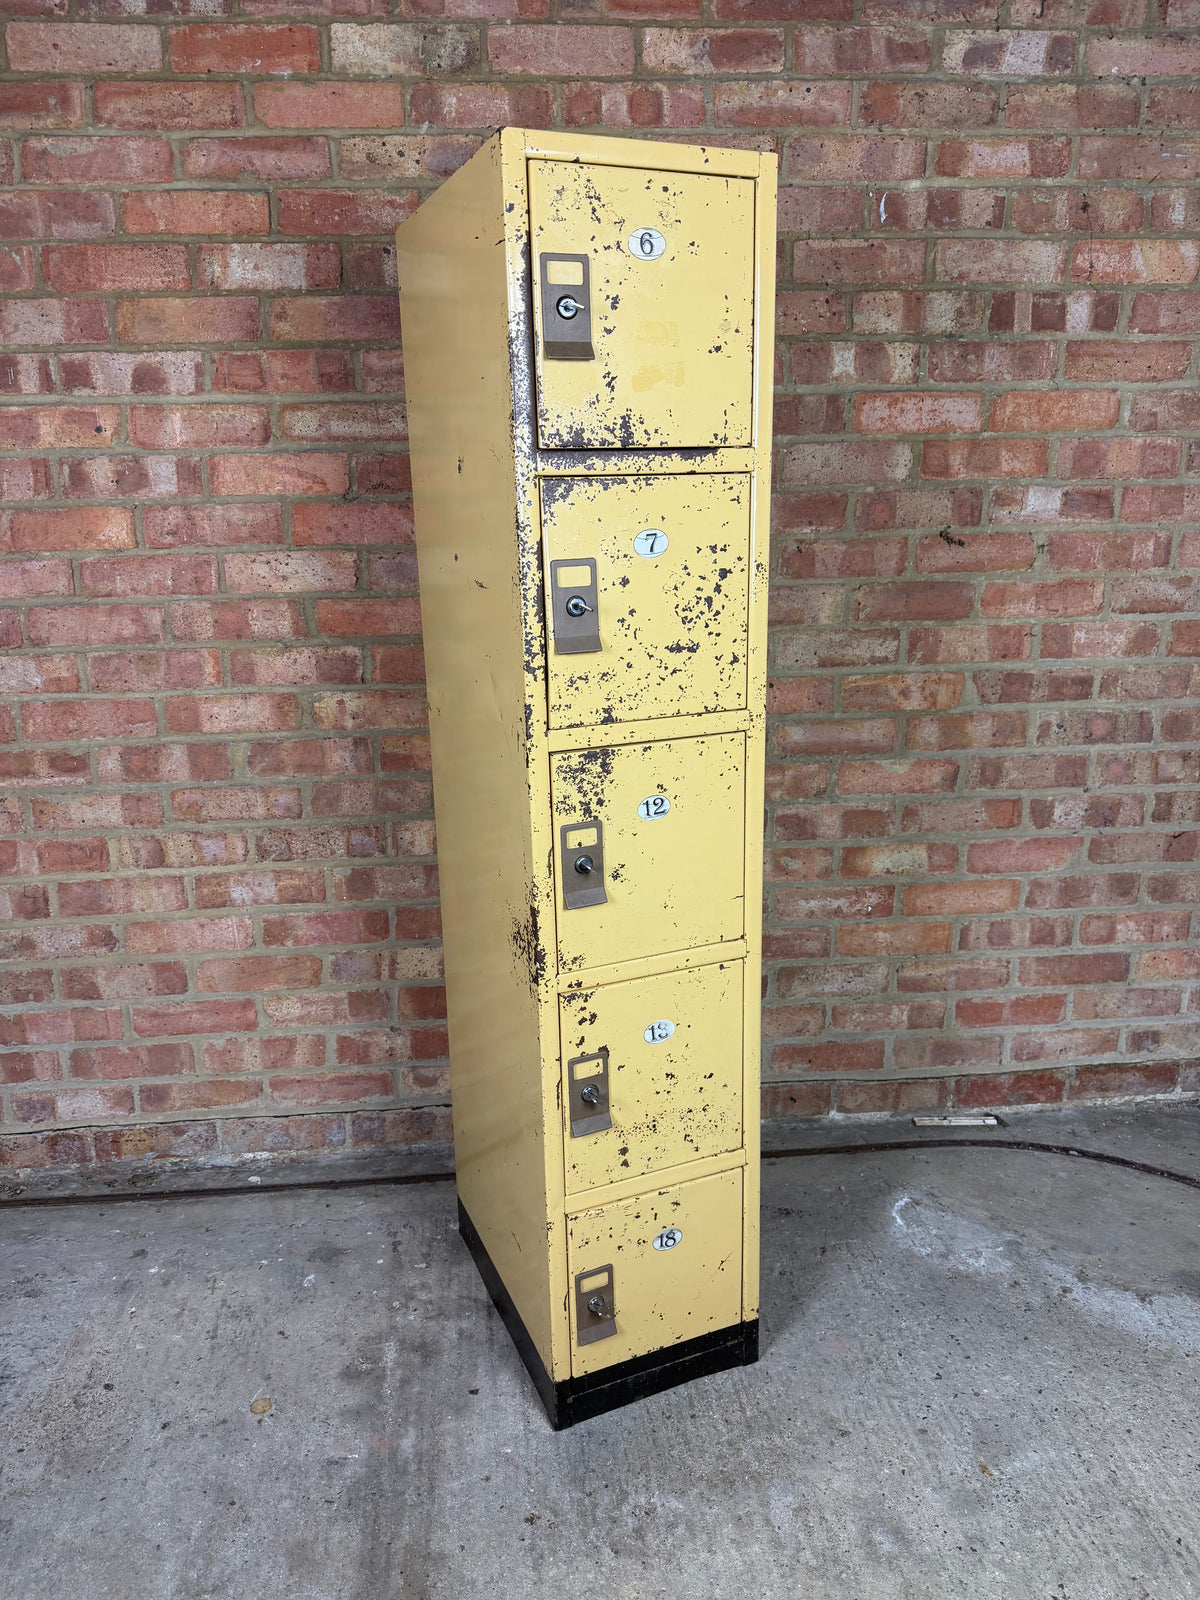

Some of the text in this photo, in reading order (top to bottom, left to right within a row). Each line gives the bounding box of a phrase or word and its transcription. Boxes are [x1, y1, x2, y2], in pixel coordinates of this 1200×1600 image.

[640, 232, 653, 255] 6
[645, 532, 657, 553] 7
[643, 797, 667, 817] 12
[657, 1230, 677, 1249] 18
